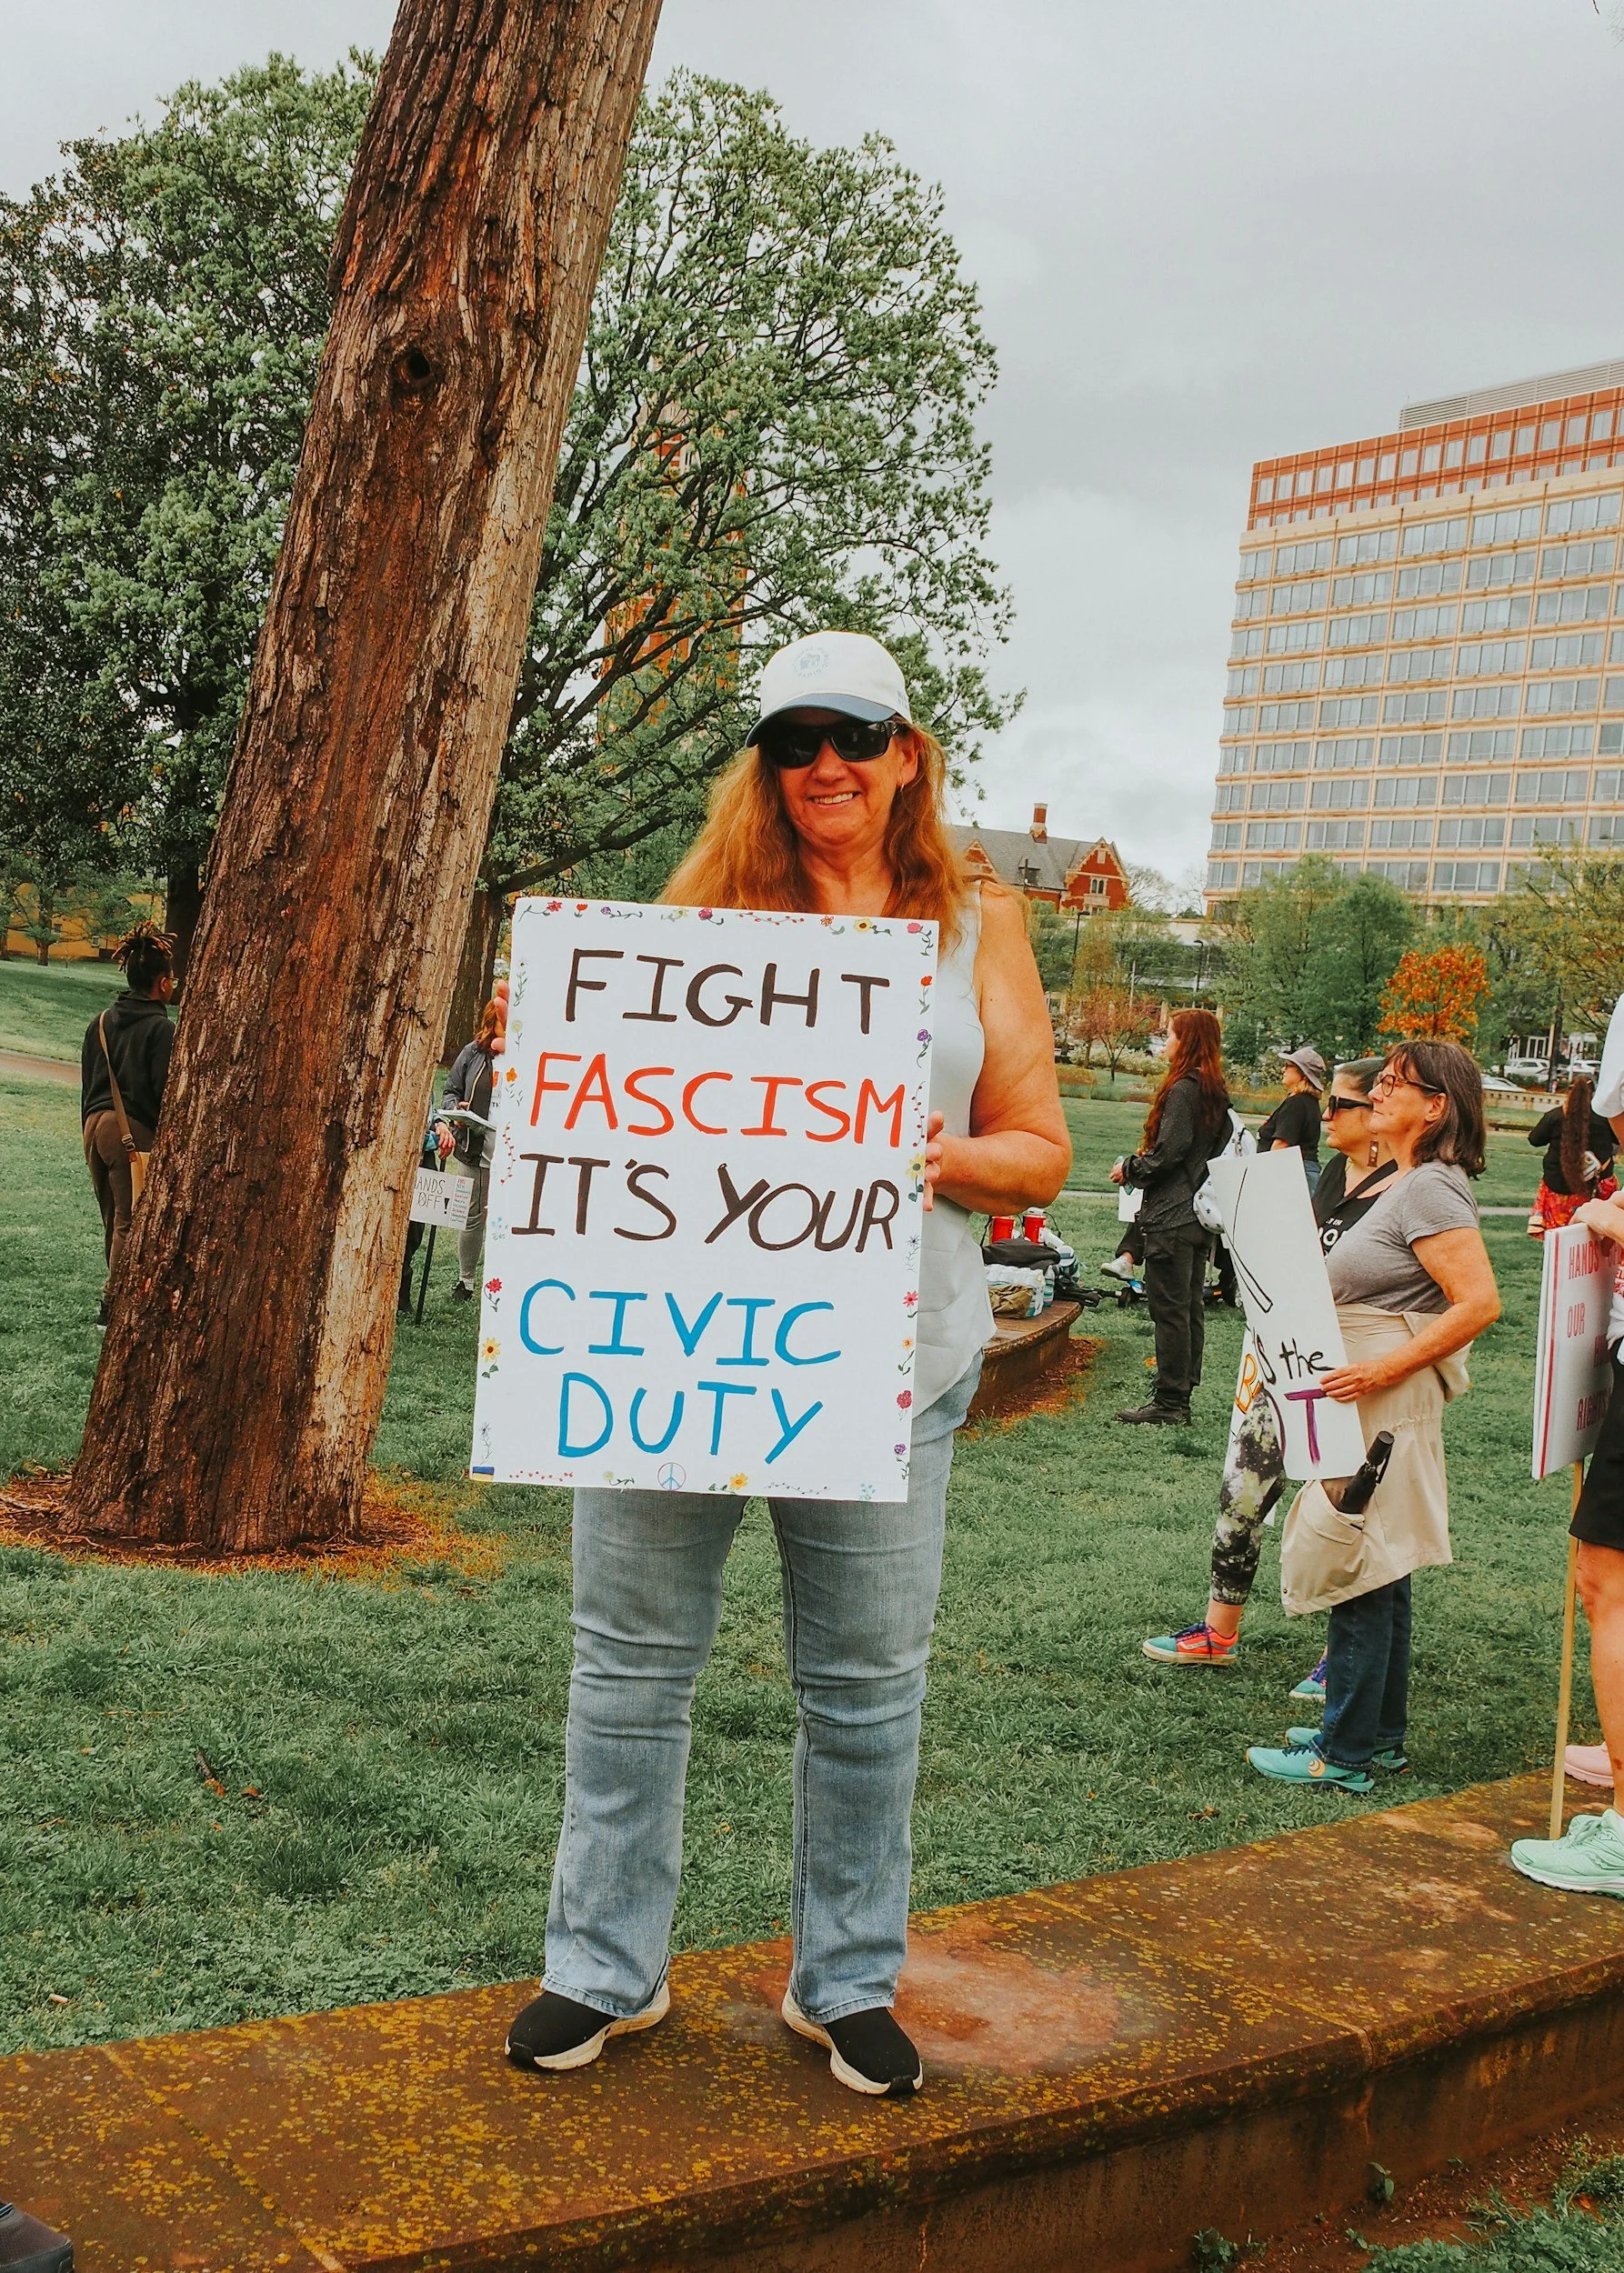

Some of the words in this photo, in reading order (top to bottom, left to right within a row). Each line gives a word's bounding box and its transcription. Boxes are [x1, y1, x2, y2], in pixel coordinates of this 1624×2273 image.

[566, 948, 890, 1035] FIGHT
[529, 1051, 906, 1148] FASCISM
[415, 1175, 446, 1196] ANDS
[511, 1154, 677, 1241] IT'S
[704, 1163, 899, 1254] YOUR
[1569, 1240, 1599, 1280] HANDS
[519, 1278, 841, 1367] CIVIC
[1279, 1337, 1336, 1380] the
[1567, 1302, 1585, 1338] OUR
[557, 1372, 823, 1465] DUTY
